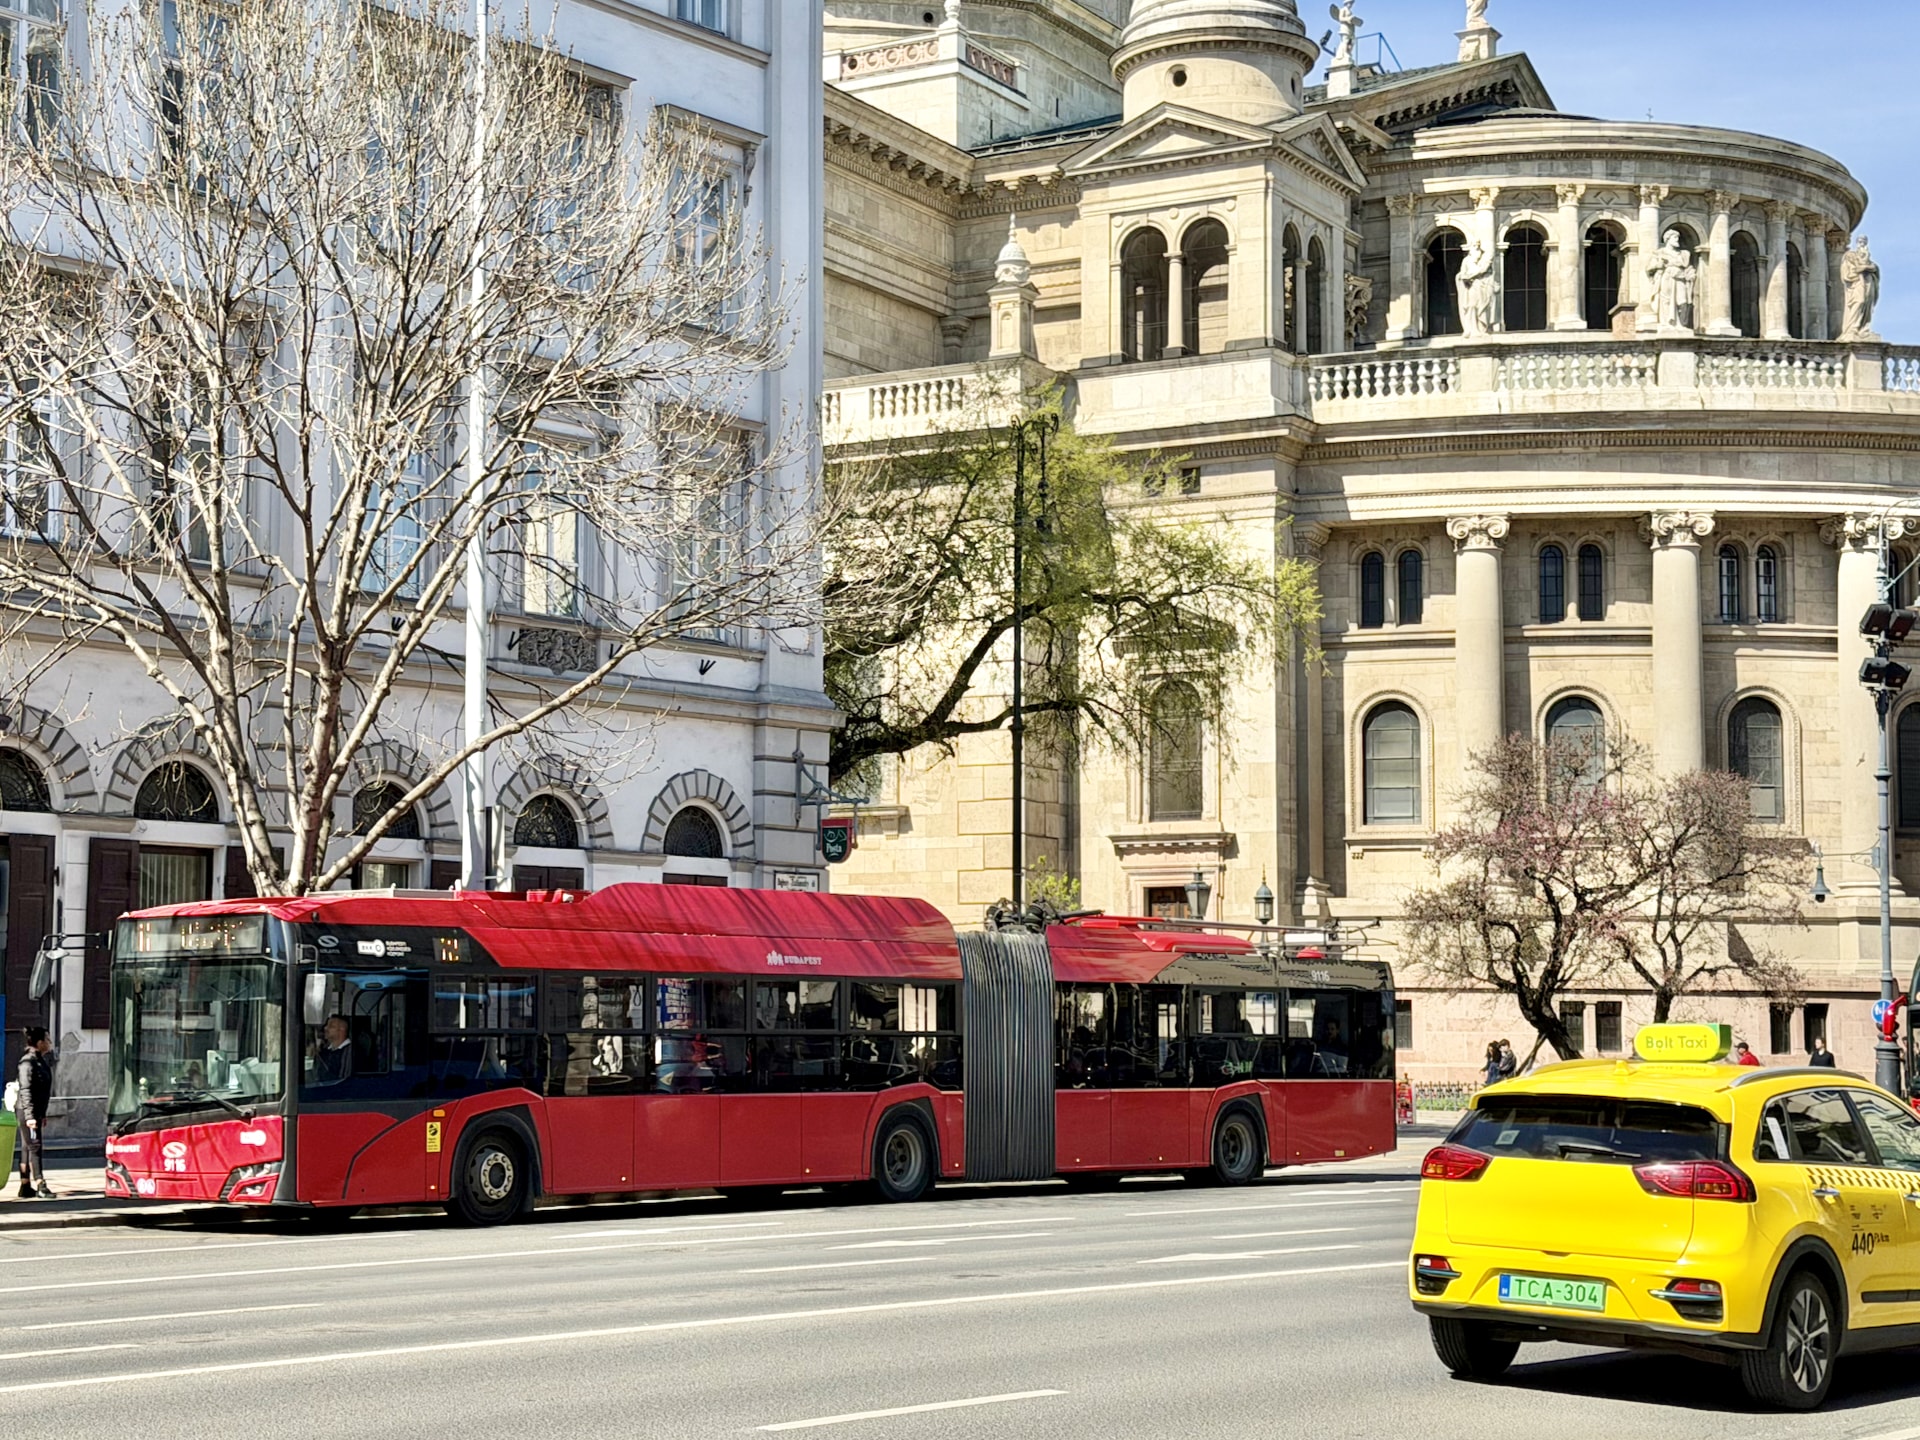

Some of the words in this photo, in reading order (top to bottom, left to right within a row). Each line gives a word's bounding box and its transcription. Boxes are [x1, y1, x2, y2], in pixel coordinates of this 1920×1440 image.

[784, 955, 822, 966] BUDAPEST
[1311, 970, 1330, 982] 9116
[1646, 1036, 1674, 1053] Bolt
[1677, 1034, 1708, 1049] Taxi
[164, 1158, 186, 1172] 9116
[1852, 1232, 1875, 1256] 440
[1515, 1279, 1598, 1304] TCA-304
